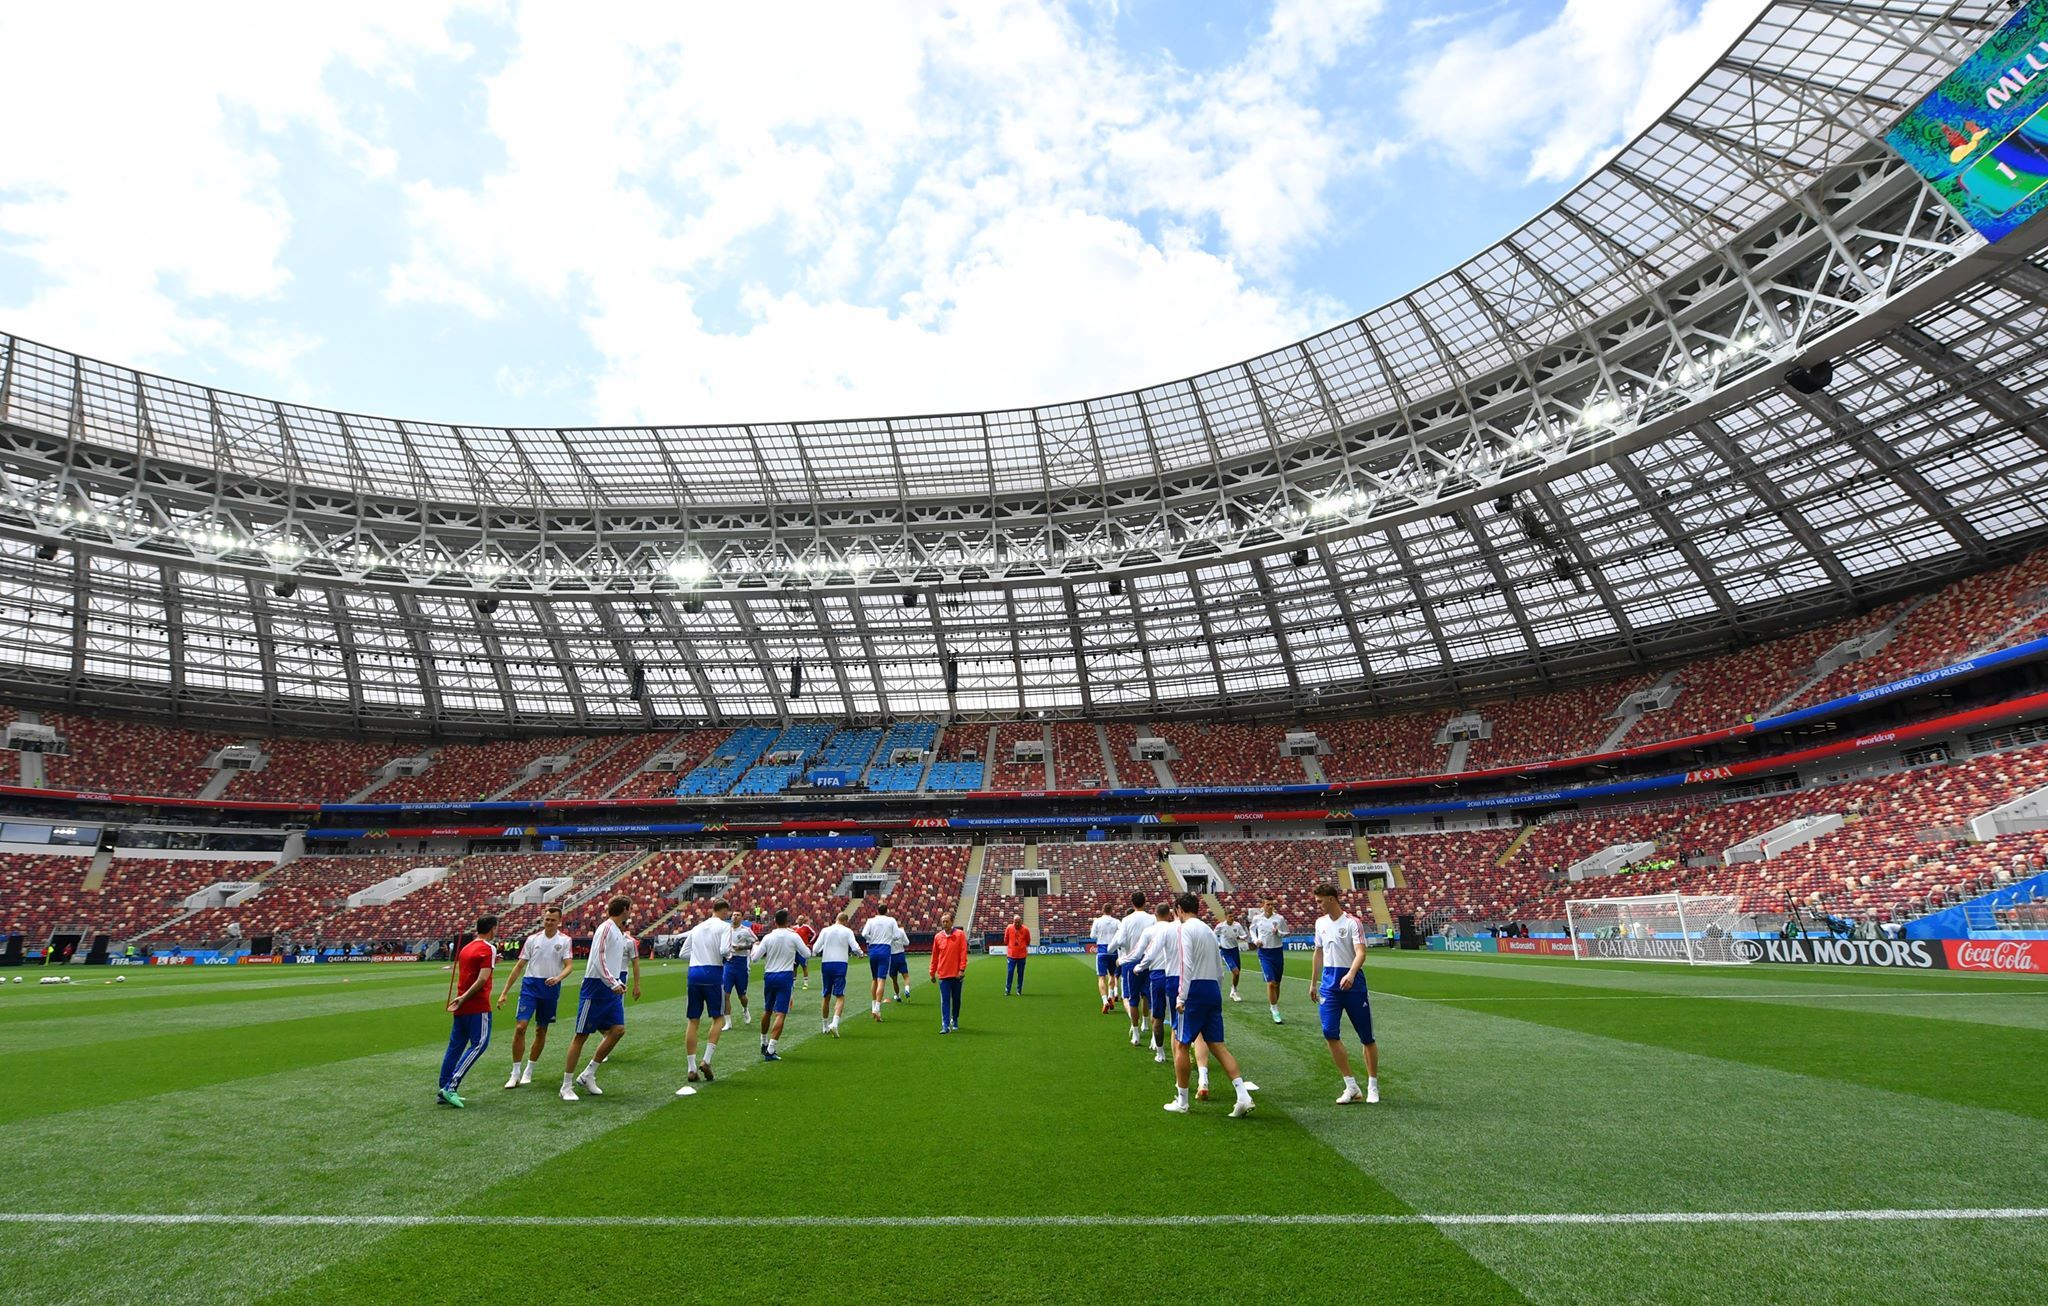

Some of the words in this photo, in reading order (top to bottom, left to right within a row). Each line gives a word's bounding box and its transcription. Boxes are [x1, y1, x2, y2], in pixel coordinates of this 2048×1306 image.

[1995, 161, 2017, 181] 1
[1858, 690, 1875, 701] 2018
[1875, 686, 1892, 696] FIFA
[1892, 677, 1921, 693] WORLD
[1921, 671, 1940, 683] CUP
[1940, 662, 1975, 678] RUSSIA
[1856, 733, 1896, 747] #worldcup
[817, 777, 840, 786] FIFA
[1496, 797, 1520, 806] WORLD
[1520, 795, 1534, 803] CUP
[1535, 792, 1561, 800] RUSSIA
[1445, 936, 1482, 952] Hisense
[1510, 941, 1536, 950] McDonald's
[1598, 939, 1640, 957] QATAR
[1735, 943, 1759, 958] KIA
[296, 955, 316, 964] VISA
[1768, 940, 1809, 963] KIA
[1814, 939, 1933, 969] MOTORS
[1957, 940, 2033, 970] Coca-Cola
